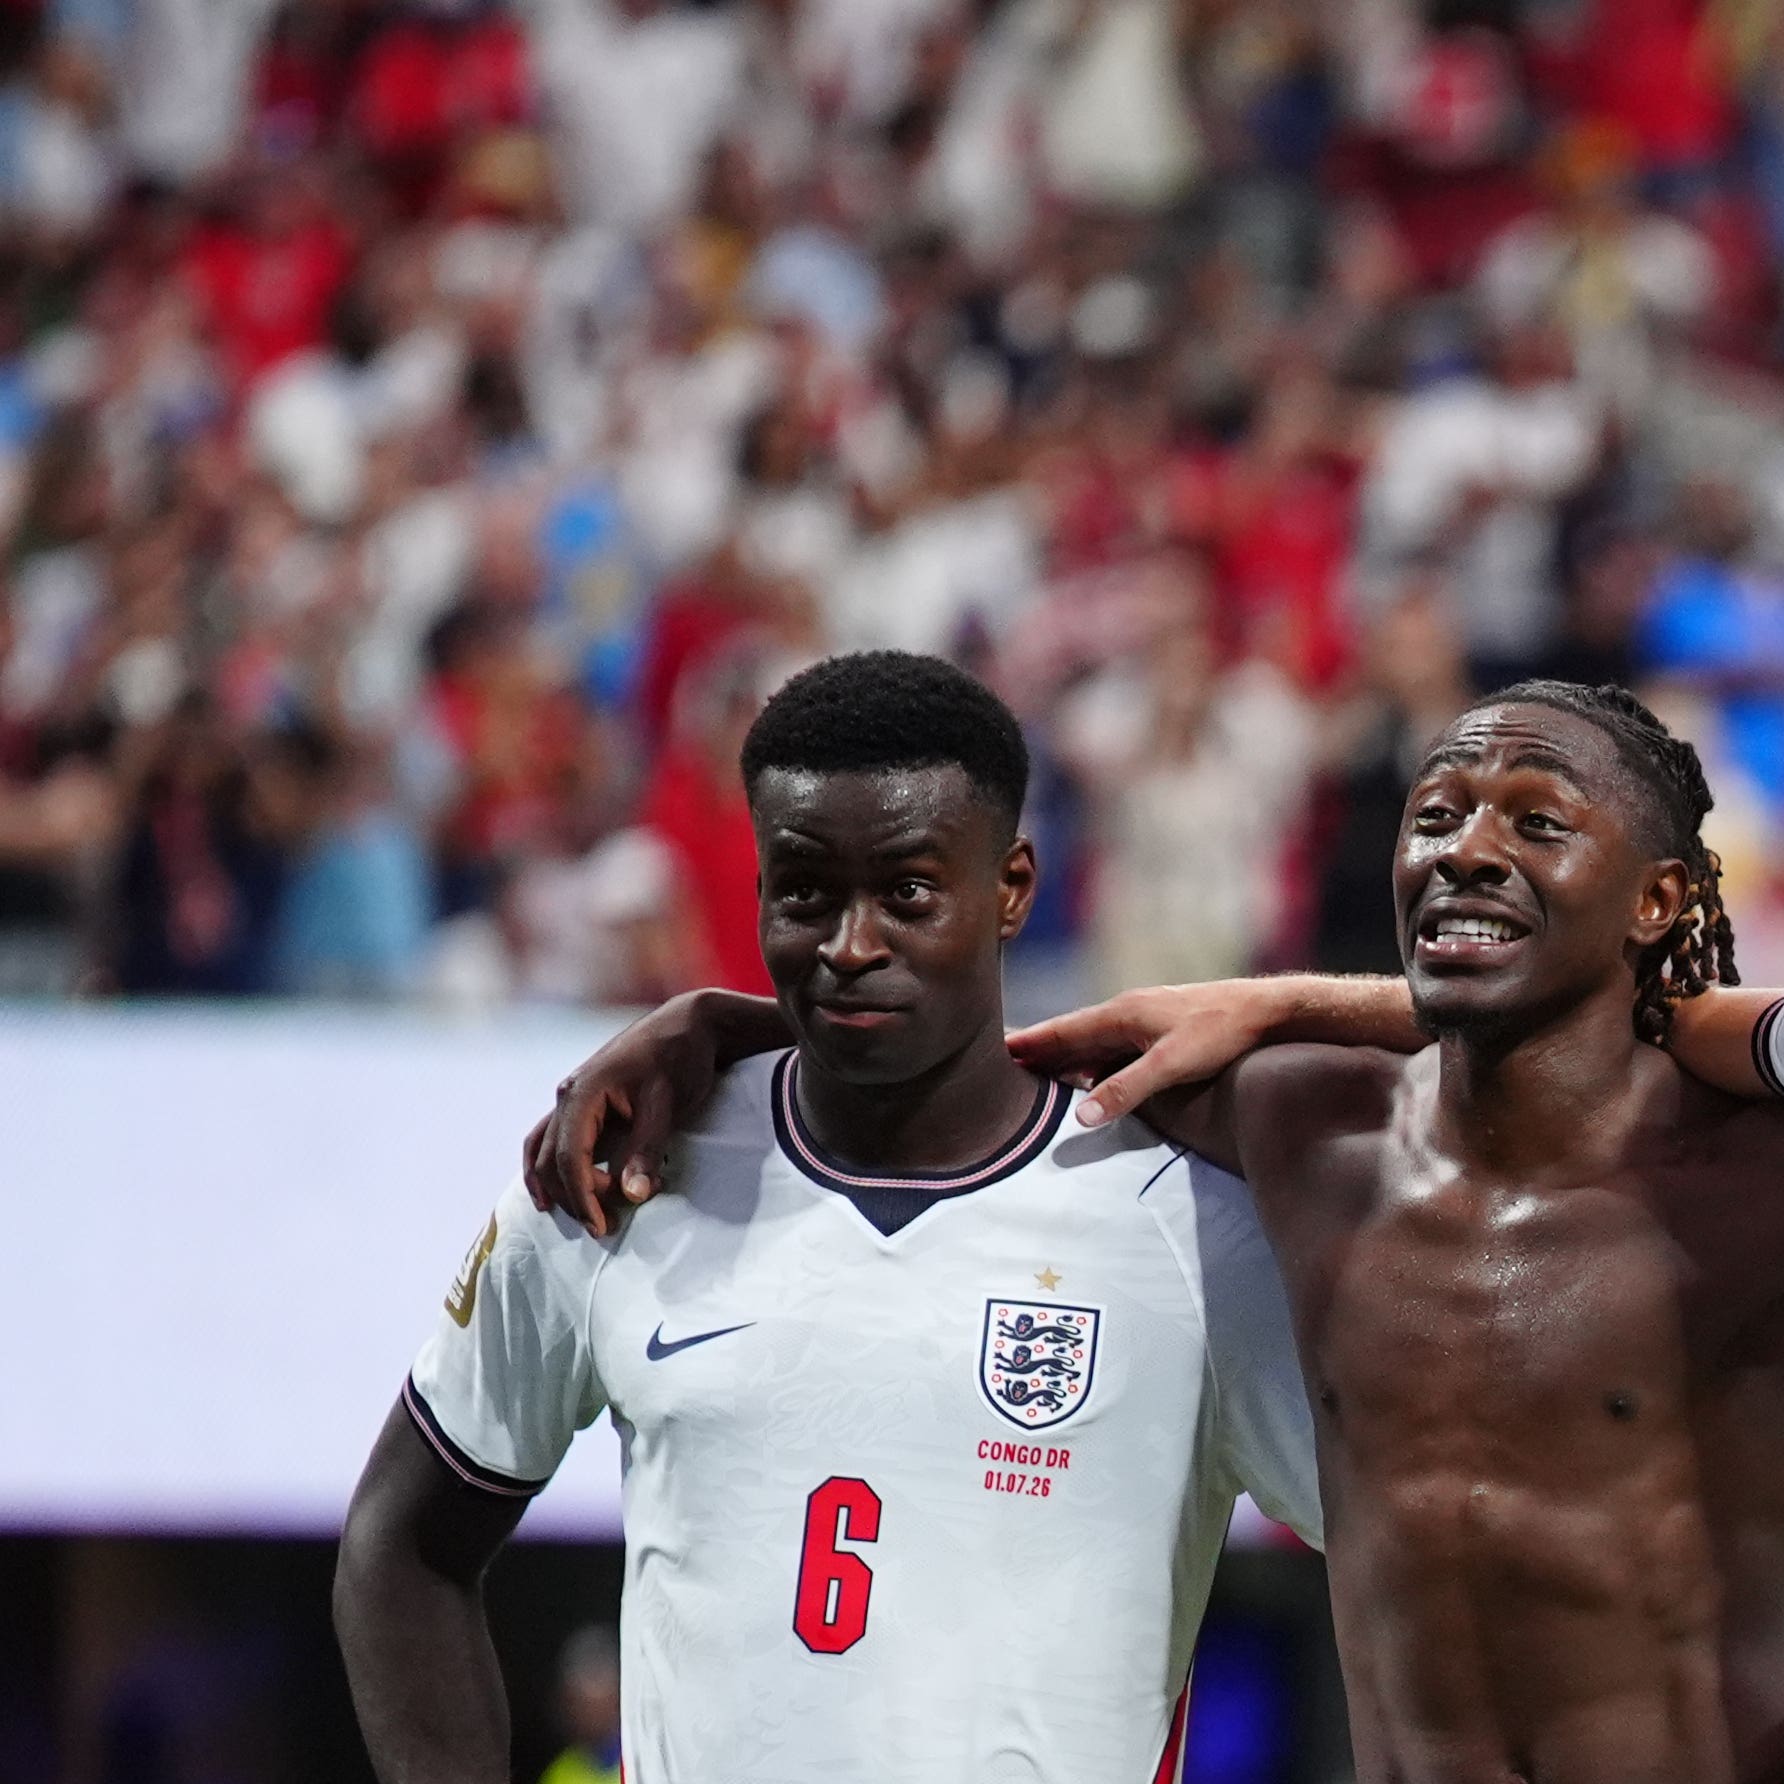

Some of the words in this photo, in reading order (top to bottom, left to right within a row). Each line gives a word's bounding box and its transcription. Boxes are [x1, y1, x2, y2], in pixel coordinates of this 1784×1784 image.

[977, 1439, 1042, 1467] CONGO
[1044, 1448, 1071, 1469] DR
[984, 1470, 1052, 1497] 01.07.26
[792, 1475, 883, 1656] 6
